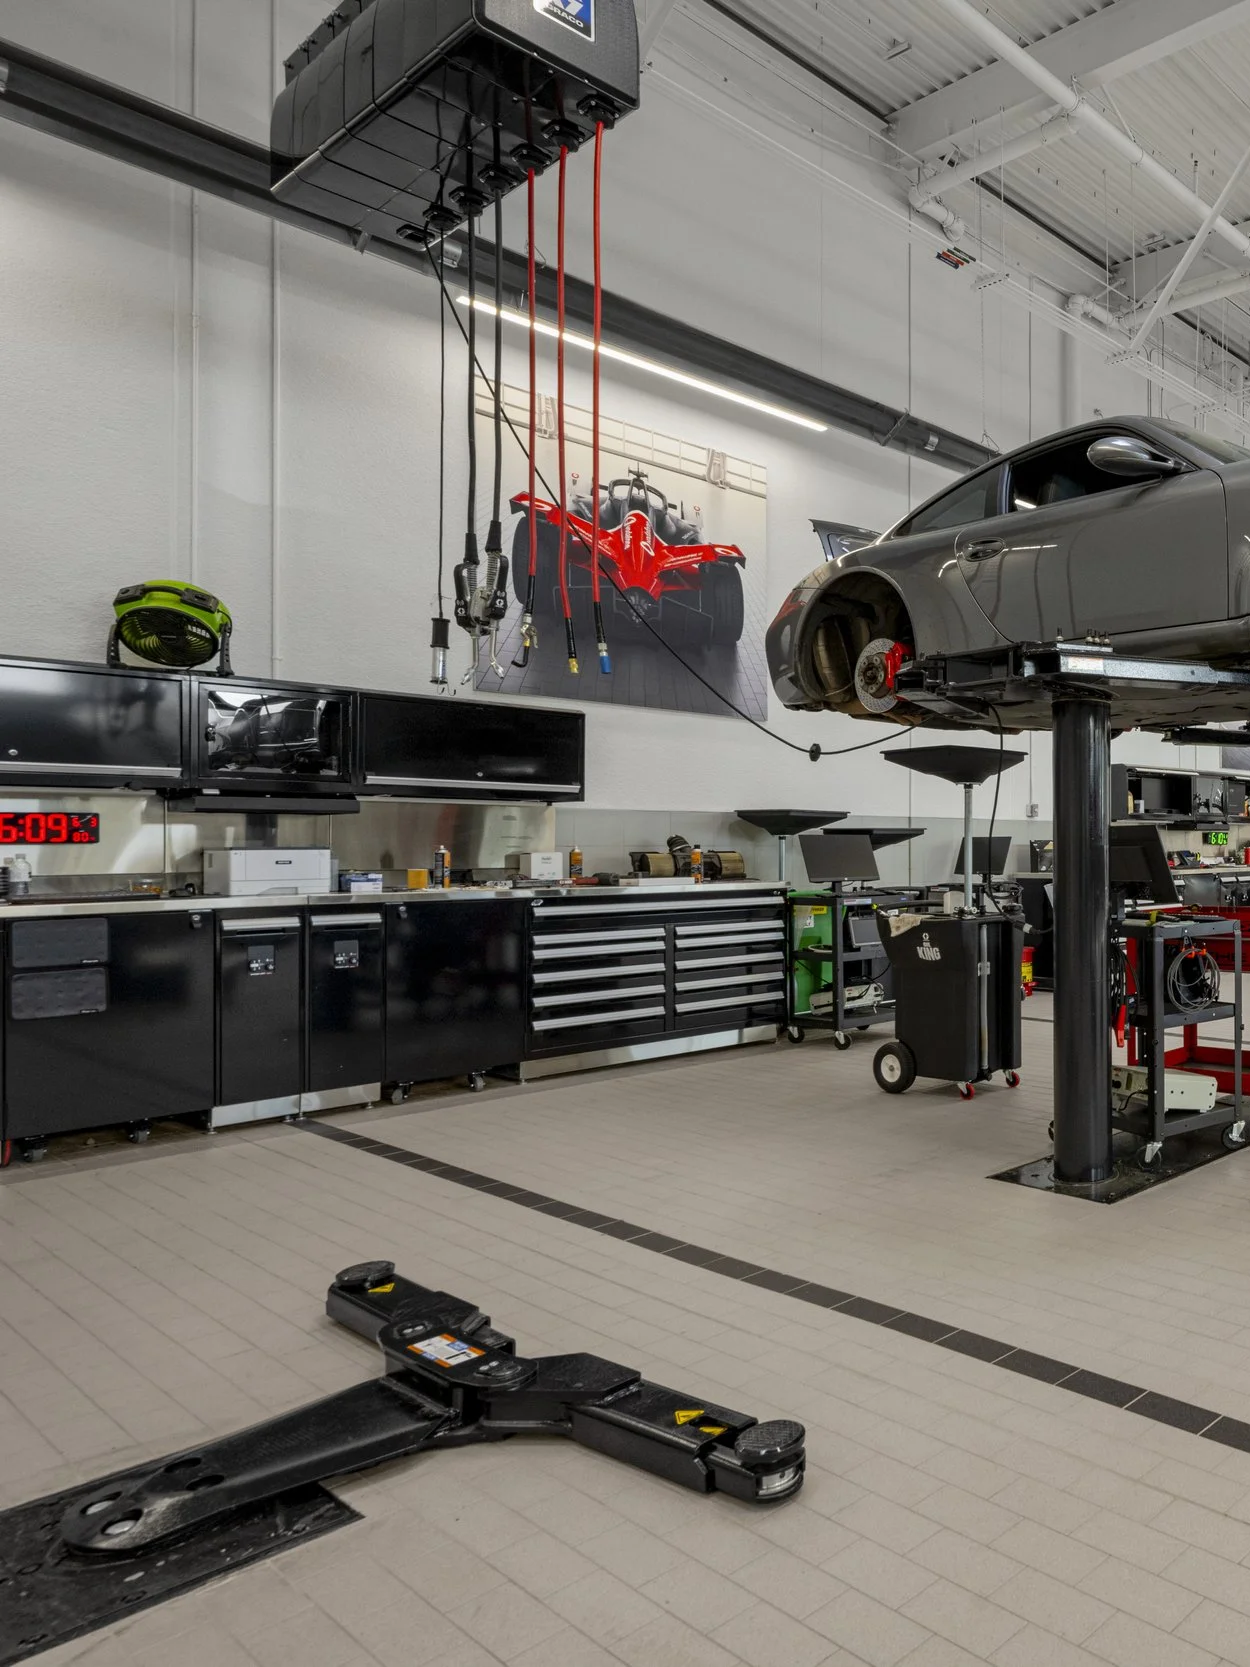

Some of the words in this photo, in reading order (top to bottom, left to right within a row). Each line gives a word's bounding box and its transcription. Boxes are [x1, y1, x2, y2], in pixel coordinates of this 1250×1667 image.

[0, 813, 68, 843] 6:09
[72, 832, 89, 842] 80
[917, 946, 941, 961] KING
